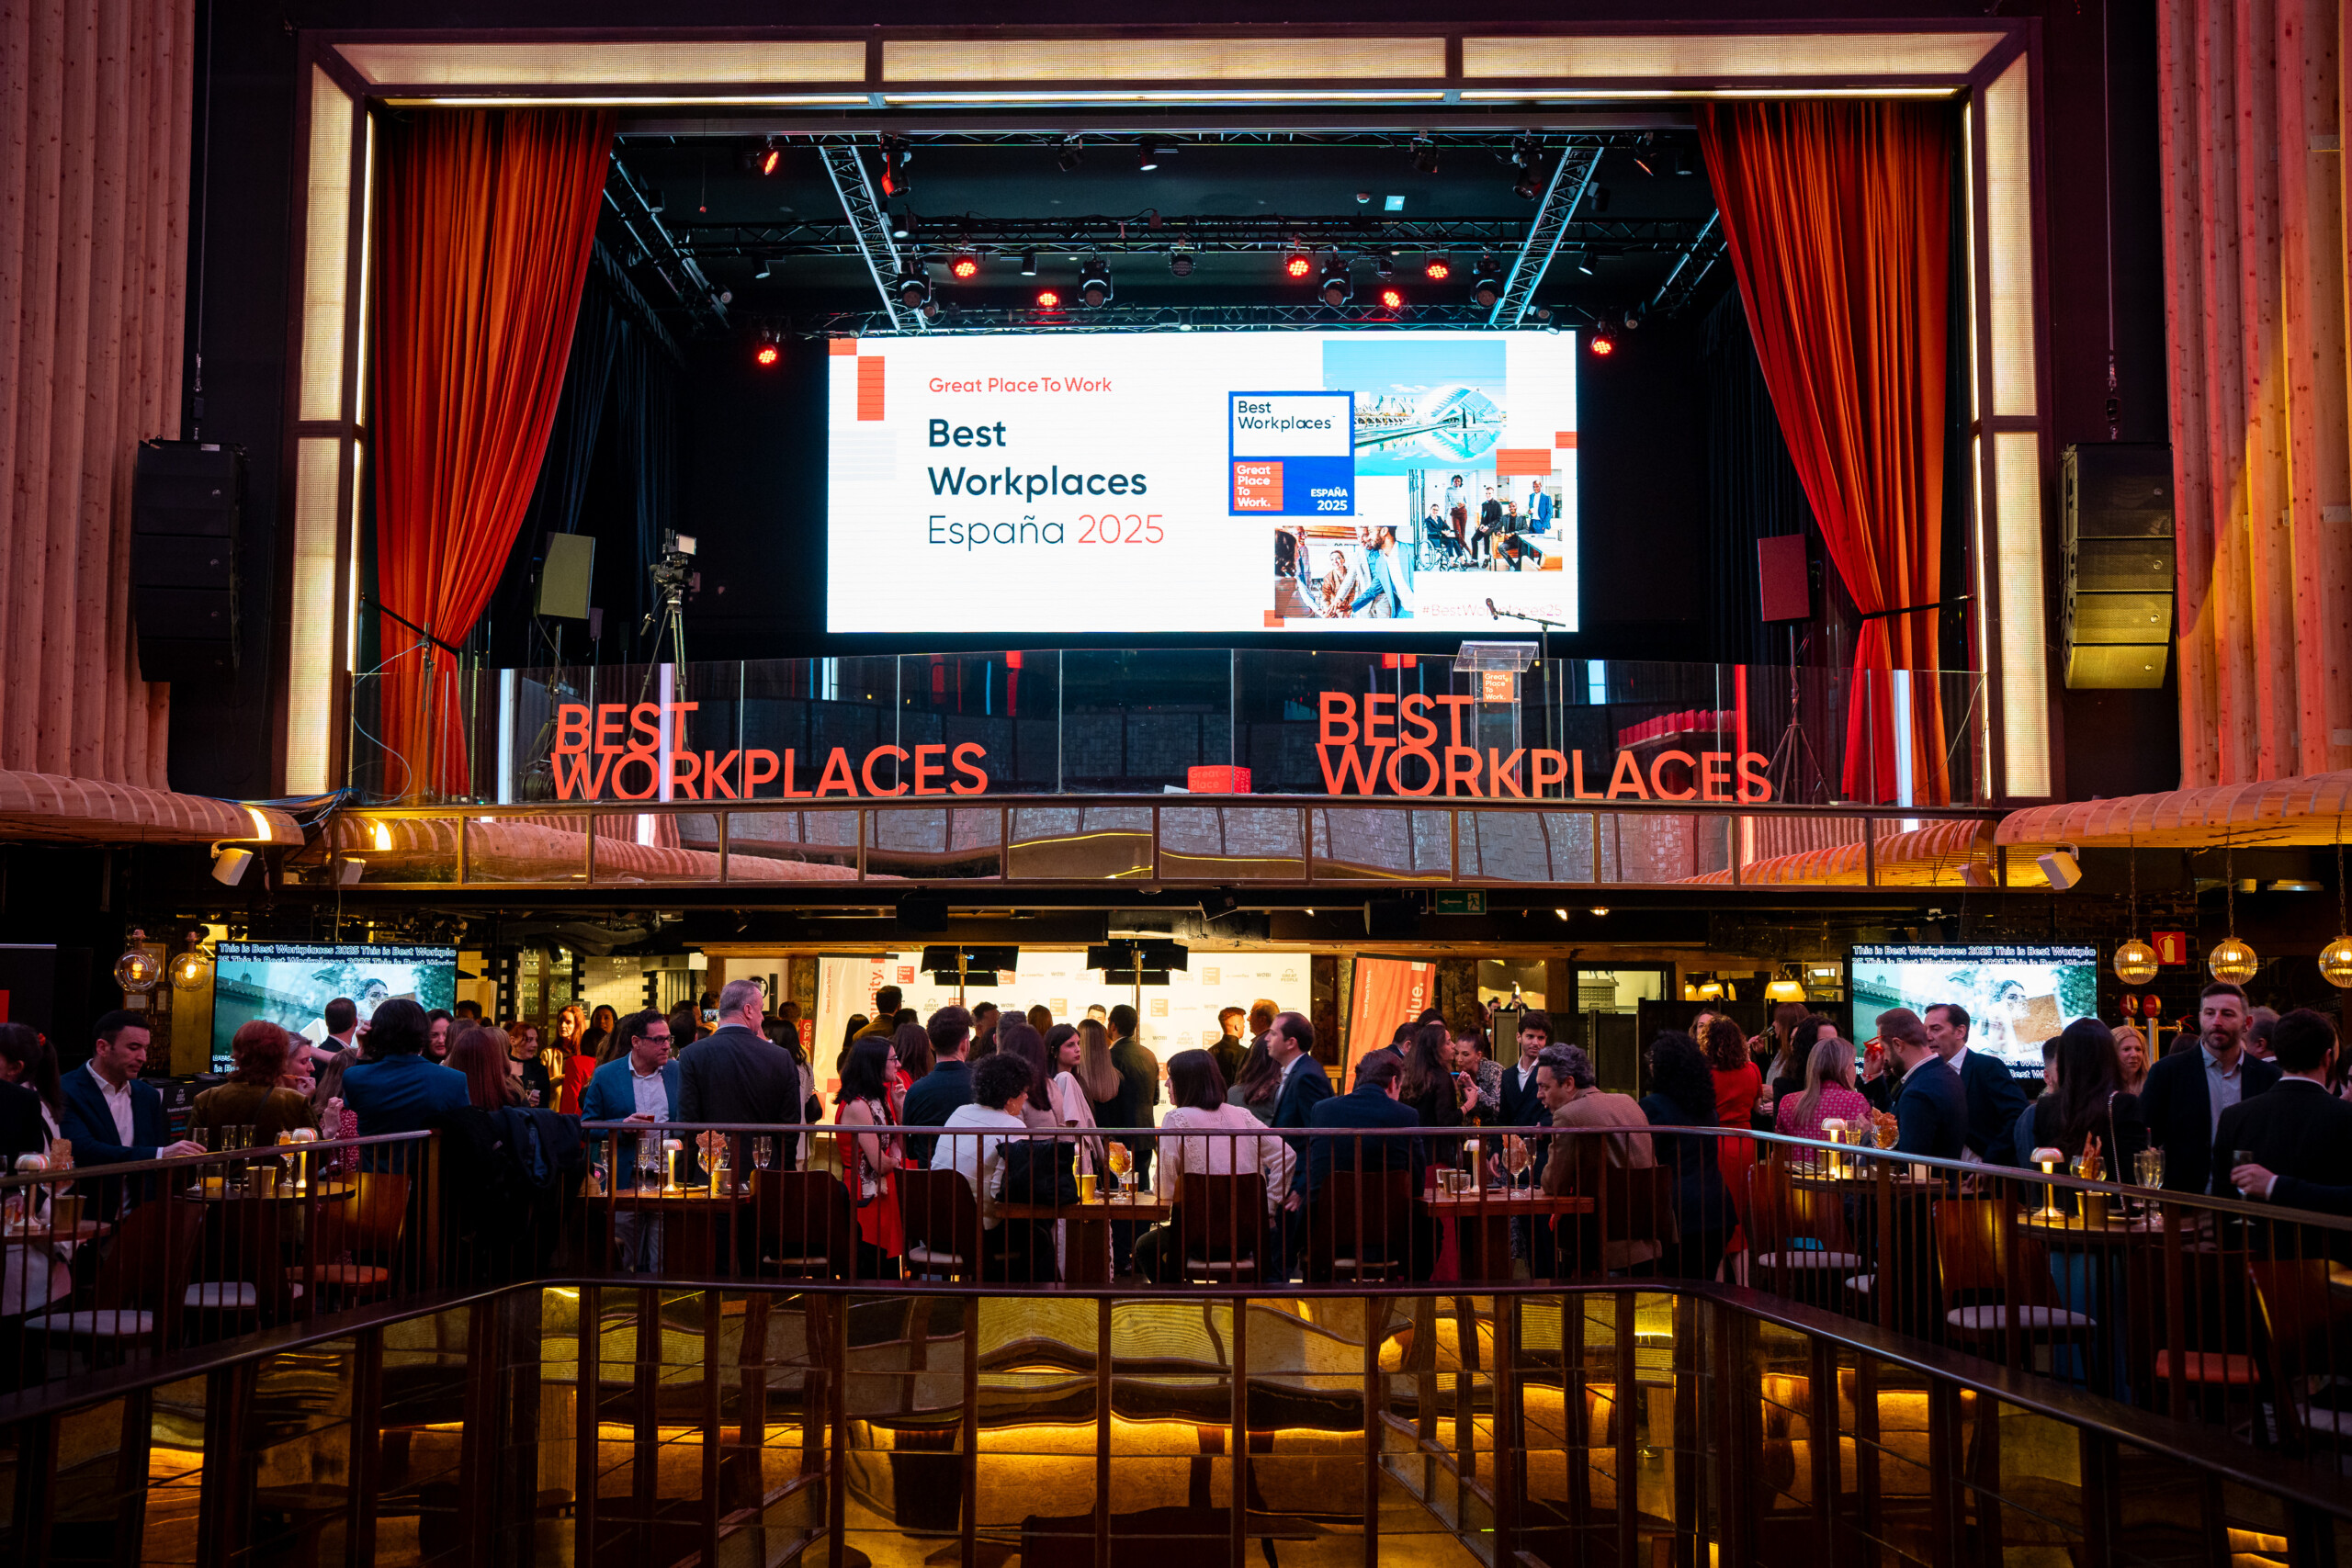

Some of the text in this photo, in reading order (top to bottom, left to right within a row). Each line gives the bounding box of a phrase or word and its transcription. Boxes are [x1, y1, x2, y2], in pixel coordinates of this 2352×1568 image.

[929, 377, 1113, 393] Great Place To Work
[1238, 400, 1272, 413] Best
[1238, 415, 1331, 433] Workplaces
[929, 418, 1006, 447] Best
[1237, 465, 1271, 475] Great
[927, 465, 1148, 503] Workplaces
[1237, 476, 1271, 485] Place
[1237, 487, 1250, 496] To
[1310, 487, 1348, 497] ESPAÑA
[1237, 497, 1271, 507] Work.
[1317, 500, 1348, 511] 2025
[929, 514, 1164, 552] España 2025
[1422, 604, 1563, 617] #BestWorplaces25
[1319, 692, 1475, 747] BEST
[554, 701, 700, 756] BEST
[550, 742, 990, 801] WORKPLACES
[1190, 769, 1220, 779] Great
[1316, 742, 1773, 803] WORKPLACES
[1191, 780, 1220, 789] Place
[219, 943, 241, 953] This
[242, 943, 250, 953] is
[252, 943, 274, 953] Best
[276, 944, 334, 955] Workplaces
[335, 945, 359, 955] 2025
[361, 945, 381, 955] This
[382, 946, 390, 955] is
[392, 946, 413, 956] Best
[1852, 945, 1873, 955] This
[1874, 945, 1883, 955] is
[1884, 945, 1907, 955] Best
[1907, 945, 1967, 957] Workplaces
[1968, 945, 1993, 956] 2025
[1994, 946, 2016, 956] This
[2017, 946, 2026, 956] is
[2027, 946, 2051, 956] Best
[1405, 982, 1424, 1022] alue.
